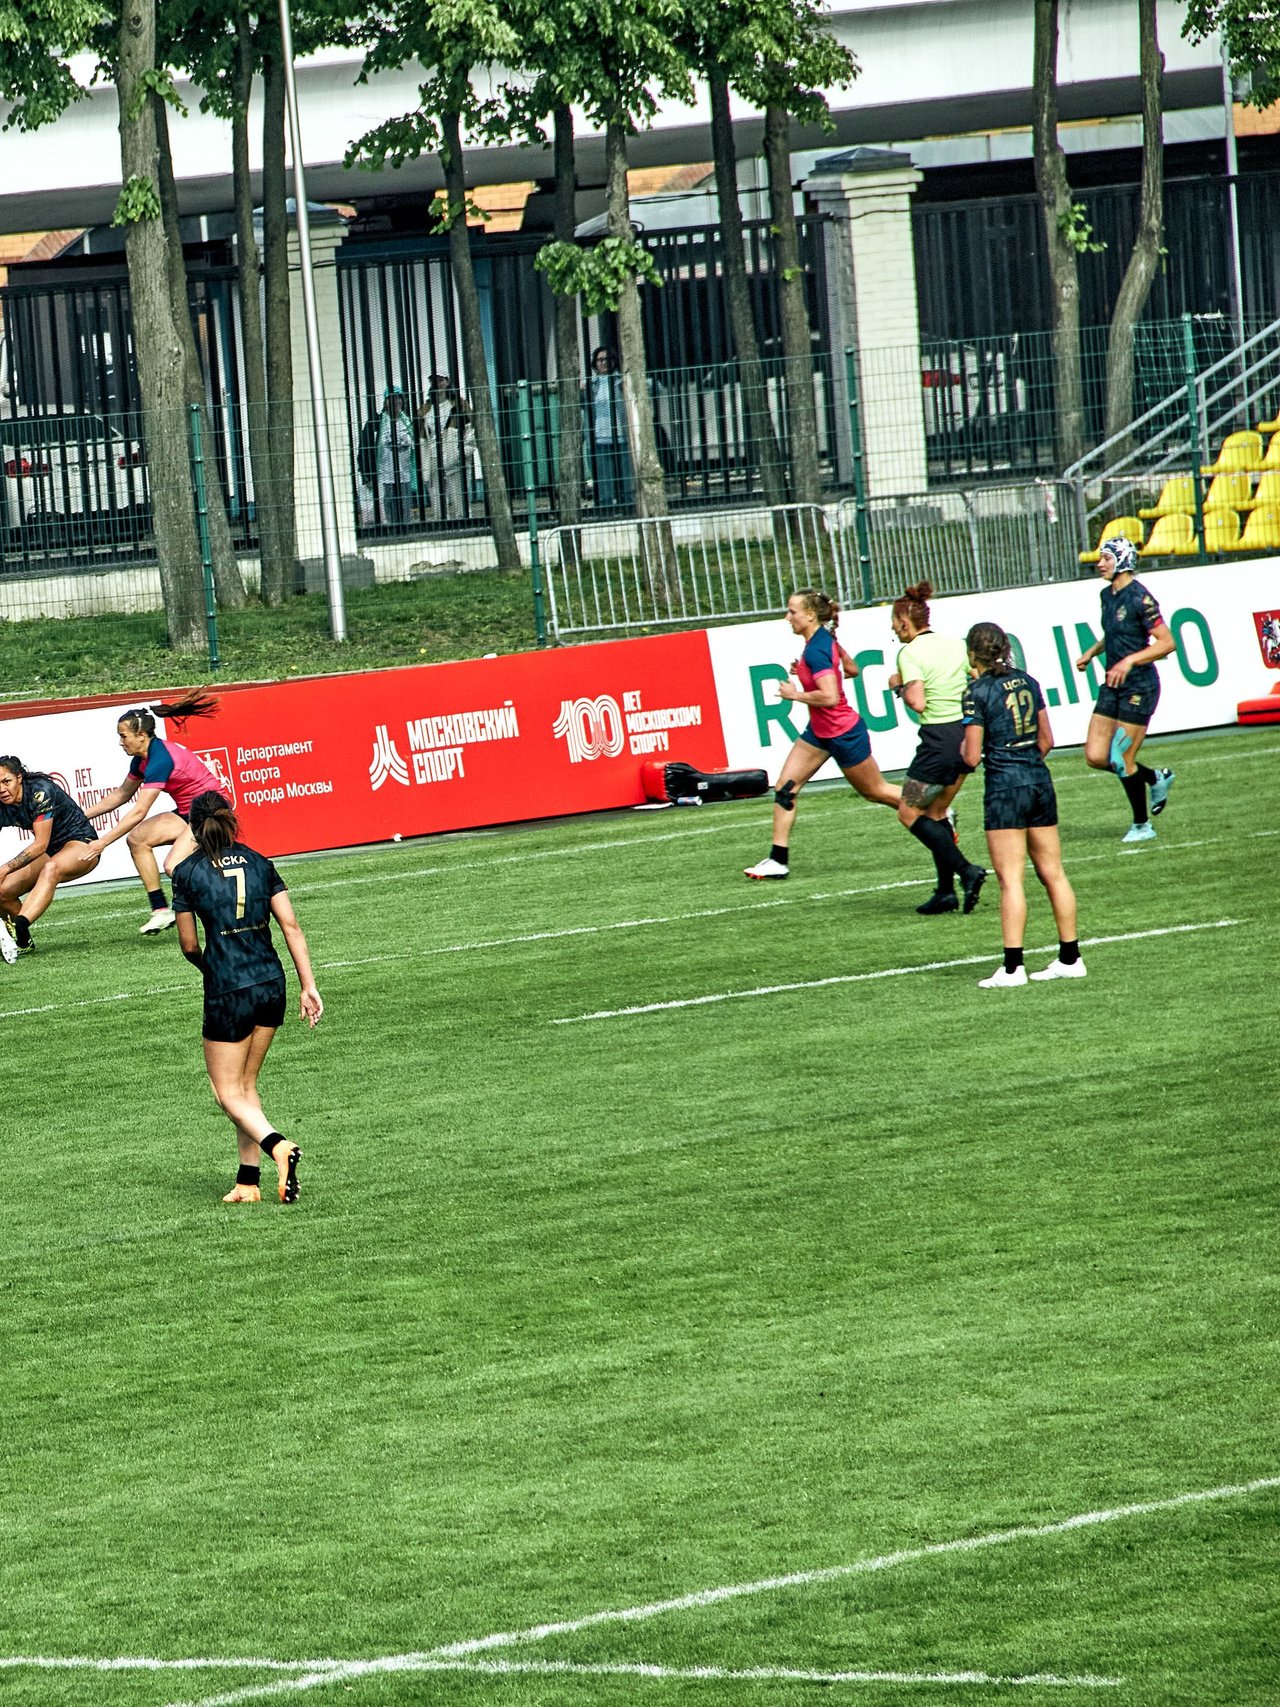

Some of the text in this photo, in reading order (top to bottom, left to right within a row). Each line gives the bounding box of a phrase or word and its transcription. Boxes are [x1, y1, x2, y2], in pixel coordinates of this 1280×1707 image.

[406, 700, 520, 752] МОСКОВСКИЙ
[552, 690, 642, 764] 100 ЛЕТ
[625, 705, 702, 734] МОСКОВСКОМУ
[1005, 689, 1037, 736] 12
[236, 740, 313, 766] Департамент
[629, 731, 669, 755] СПОРТУ
[75, 768, 92, 788] ЛЕТ
[240, 766, 281, 785] спорта
[412, 747, 465, 785] СПОРТ
[243, 780, 333, 807] города Москвы
[222, 867, 246, 920] 7
